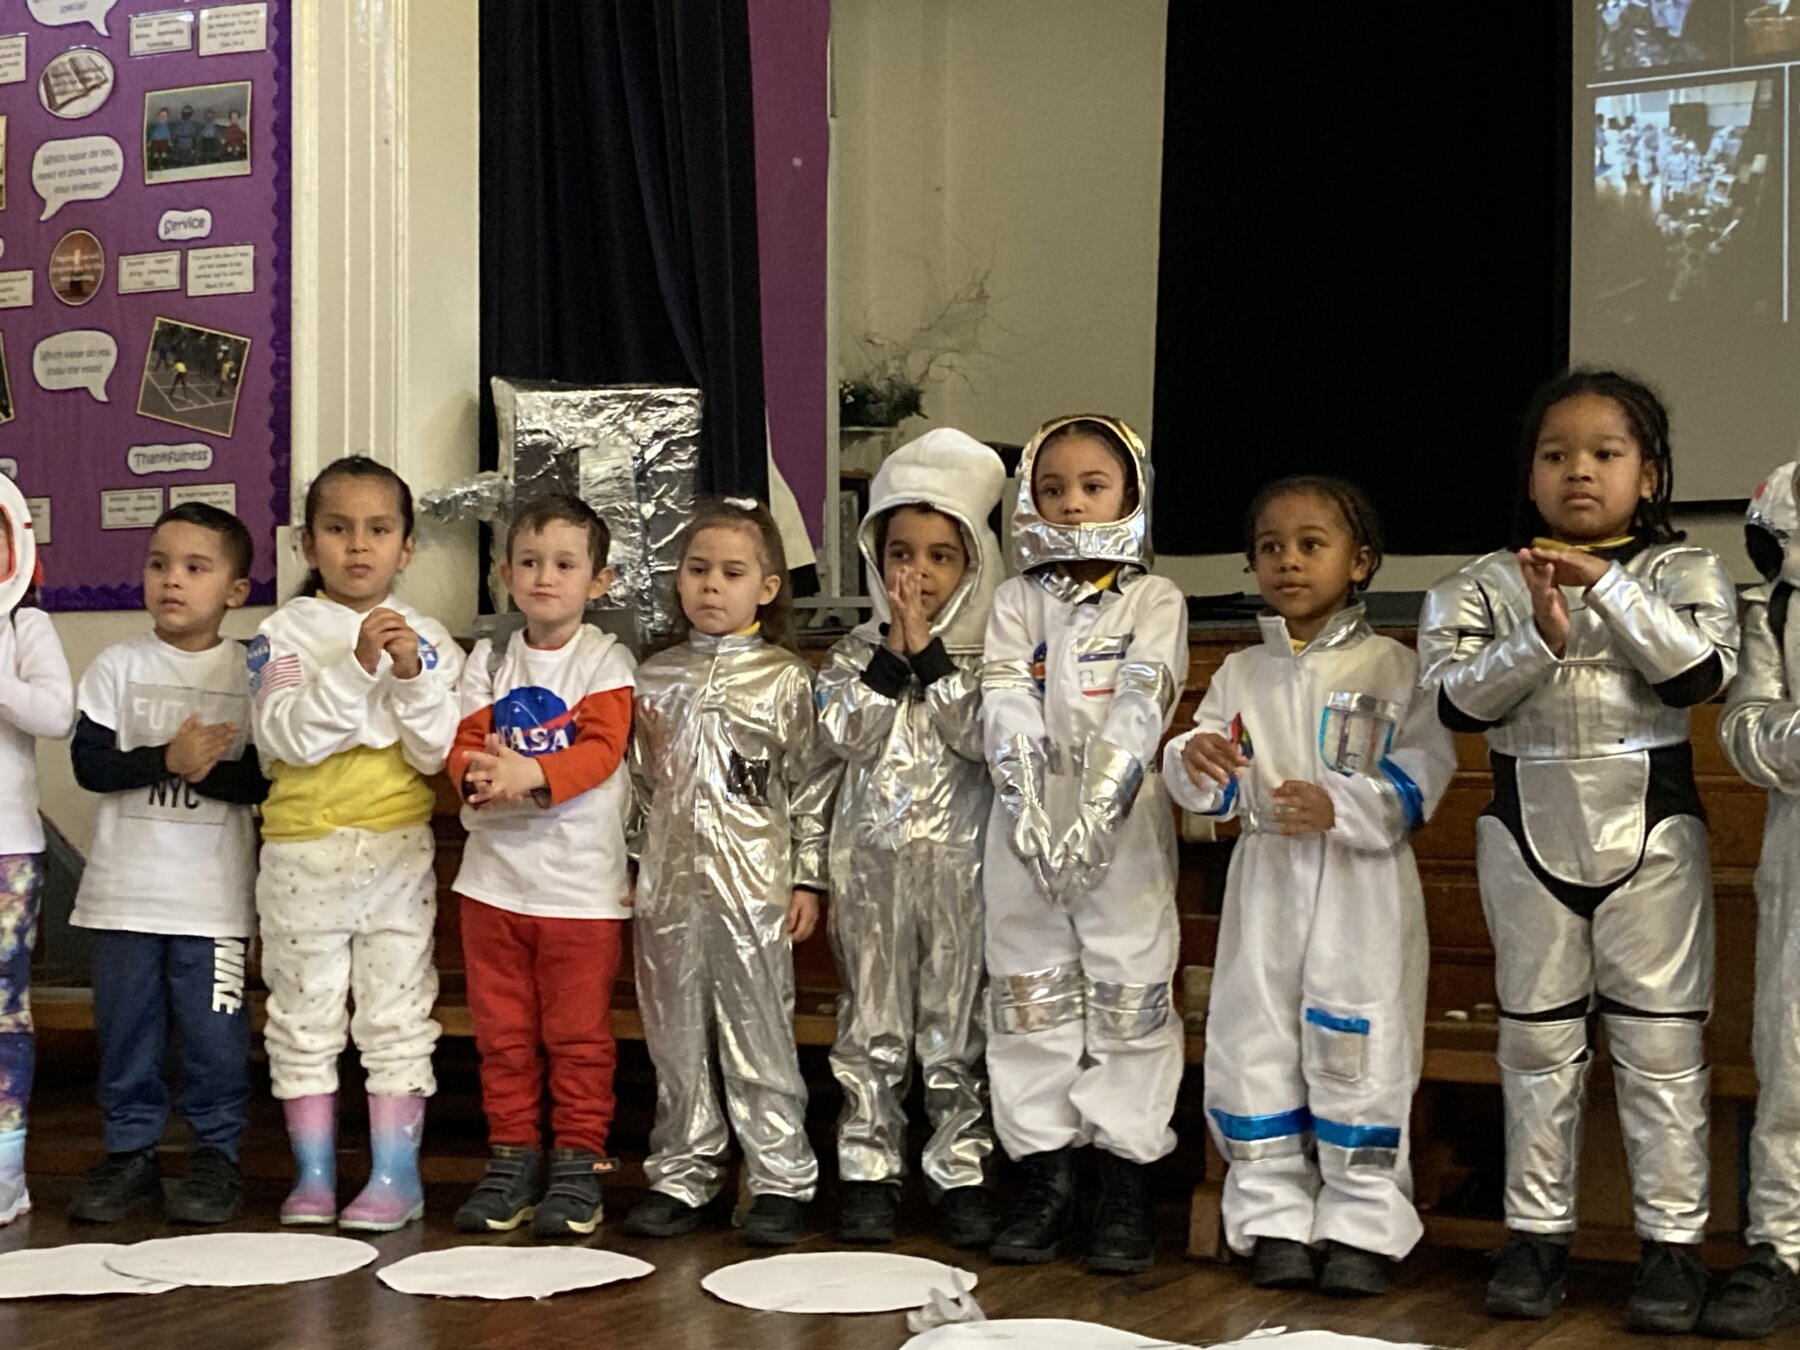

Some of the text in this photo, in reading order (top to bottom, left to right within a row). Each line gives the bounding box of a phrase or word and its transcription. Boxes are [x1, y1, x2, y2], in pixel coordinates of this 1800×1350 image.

[164, 216, 205, 235] Service
[134, 450, 208, 467] Thankfulness
[212, 937, 245, 1015] NIKE
